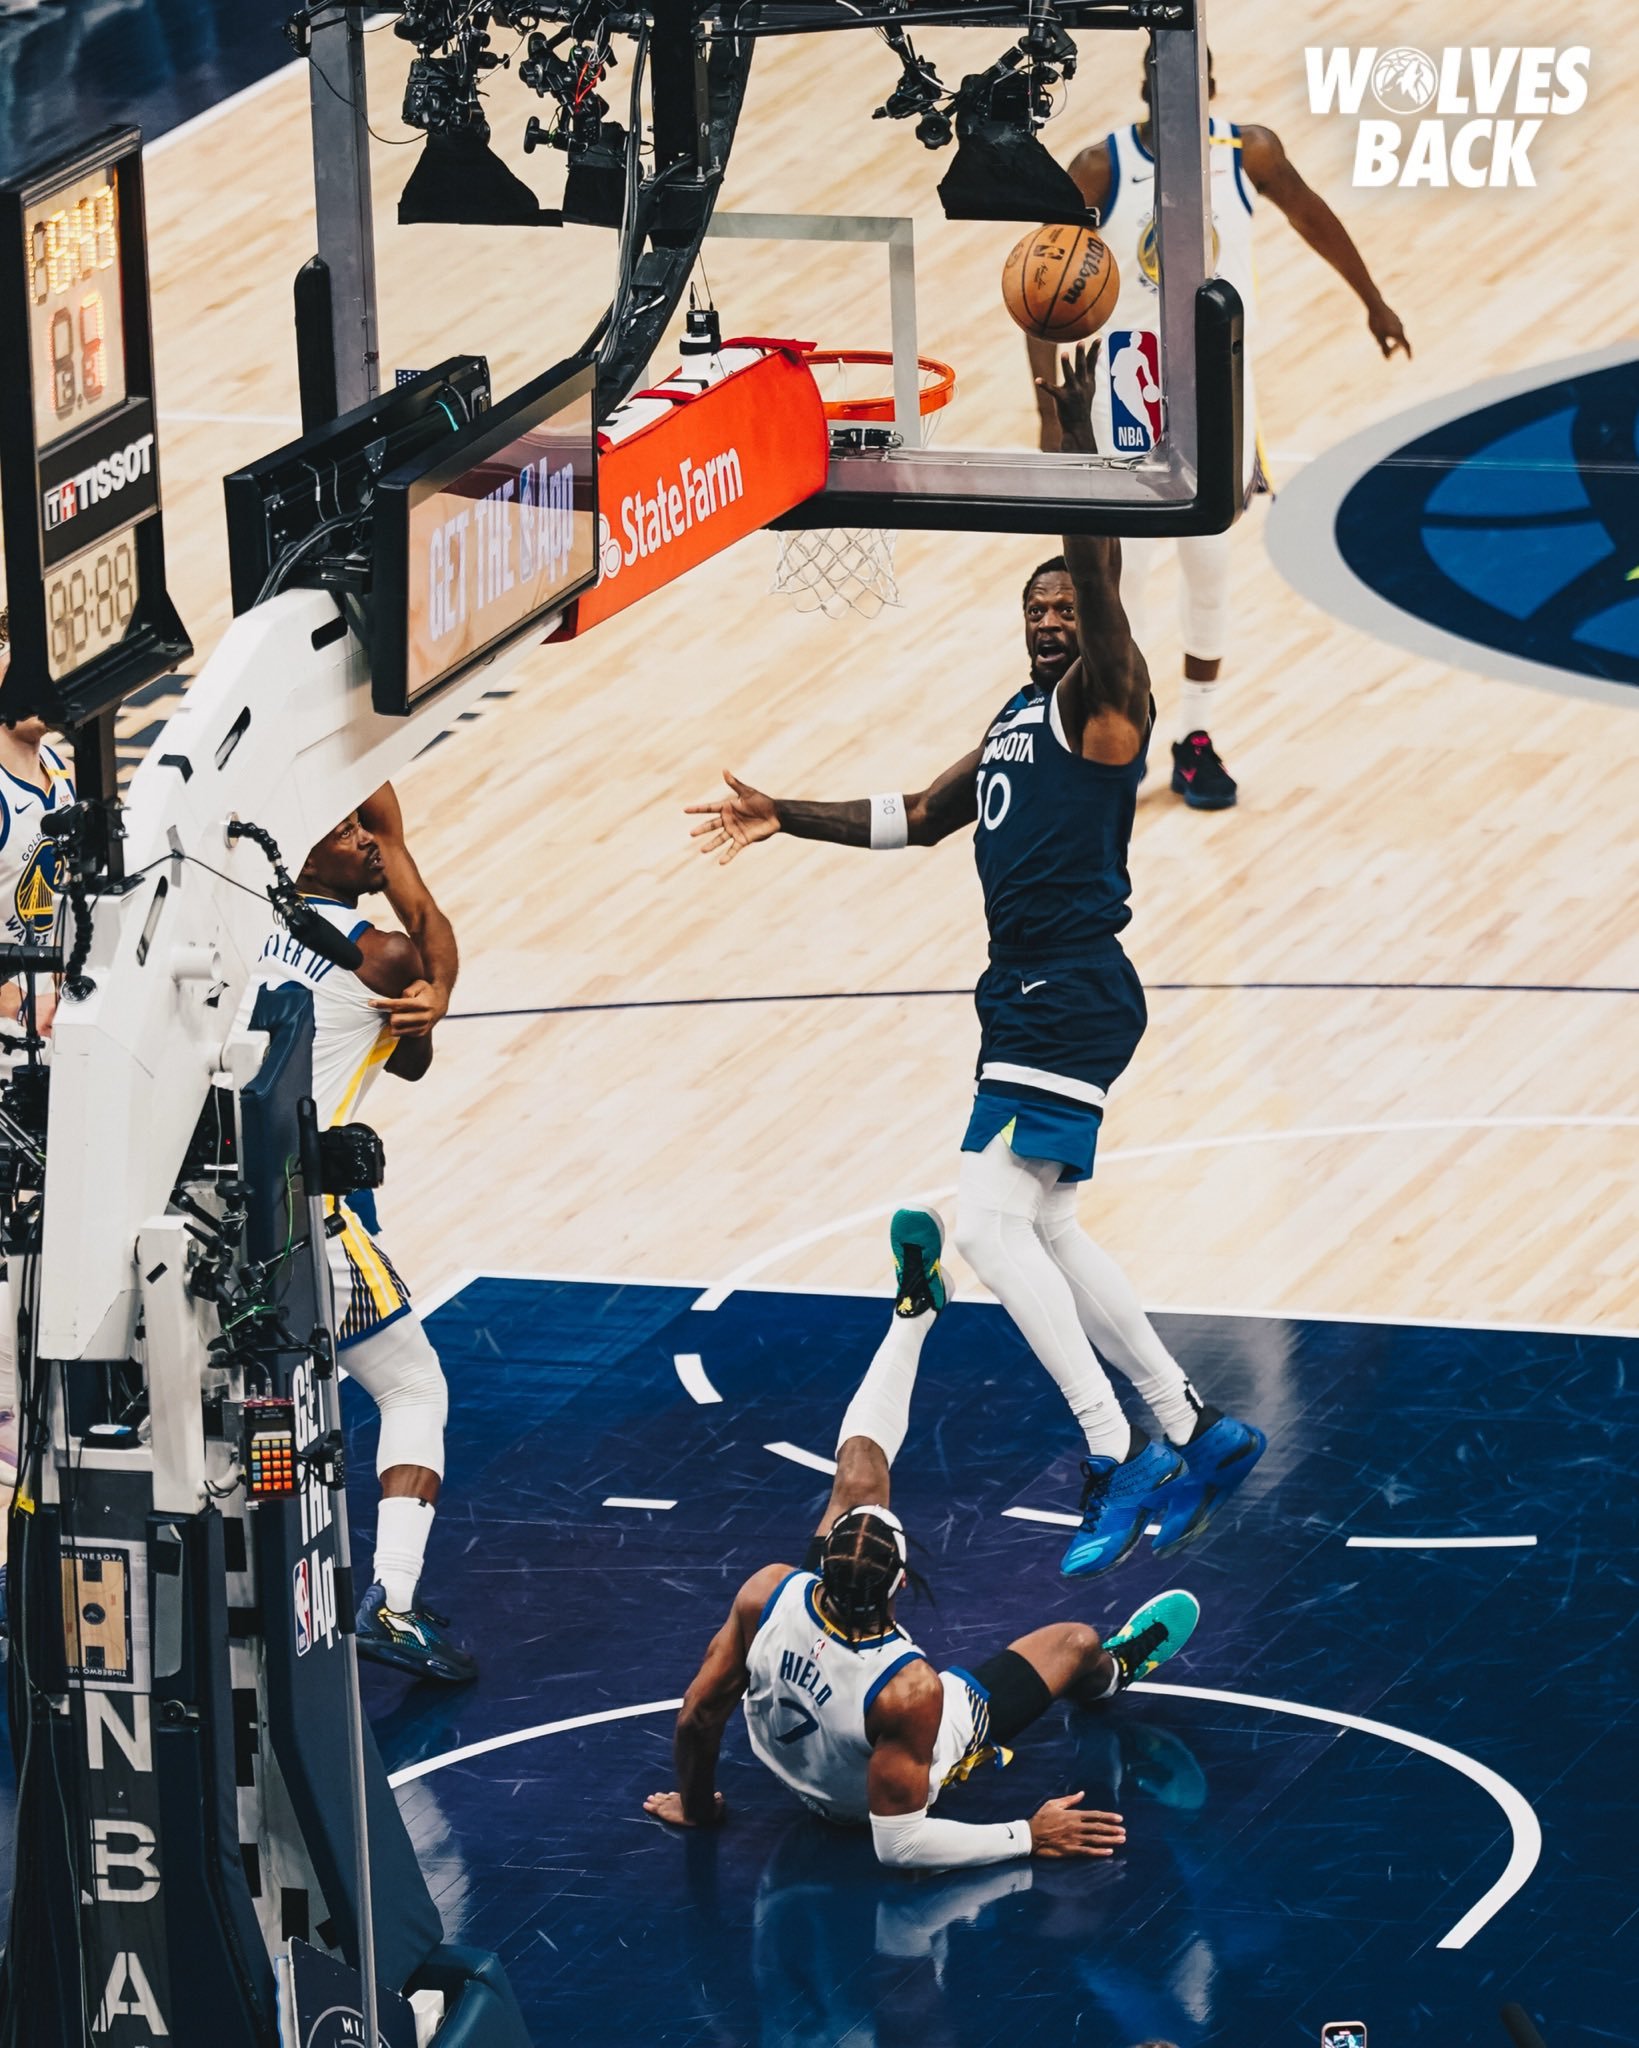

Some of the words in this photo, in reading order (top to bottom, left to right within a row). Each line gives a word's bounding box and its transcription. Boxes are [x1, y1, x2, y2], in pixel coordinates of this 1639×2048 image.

[1061, 236, 1105, 305] Wilson
[1118, 426, 1145, 447] NBA
[75, 433, 154, 511] TISSOT
[429, 508, 470, 642] GET
[474, 477, 515, 610] THE
[537, 456, 574, 584] App
[66, 1667, 127, 1678] TIMBERWOVE
[780, 1650, 833, 1708] HIELD
